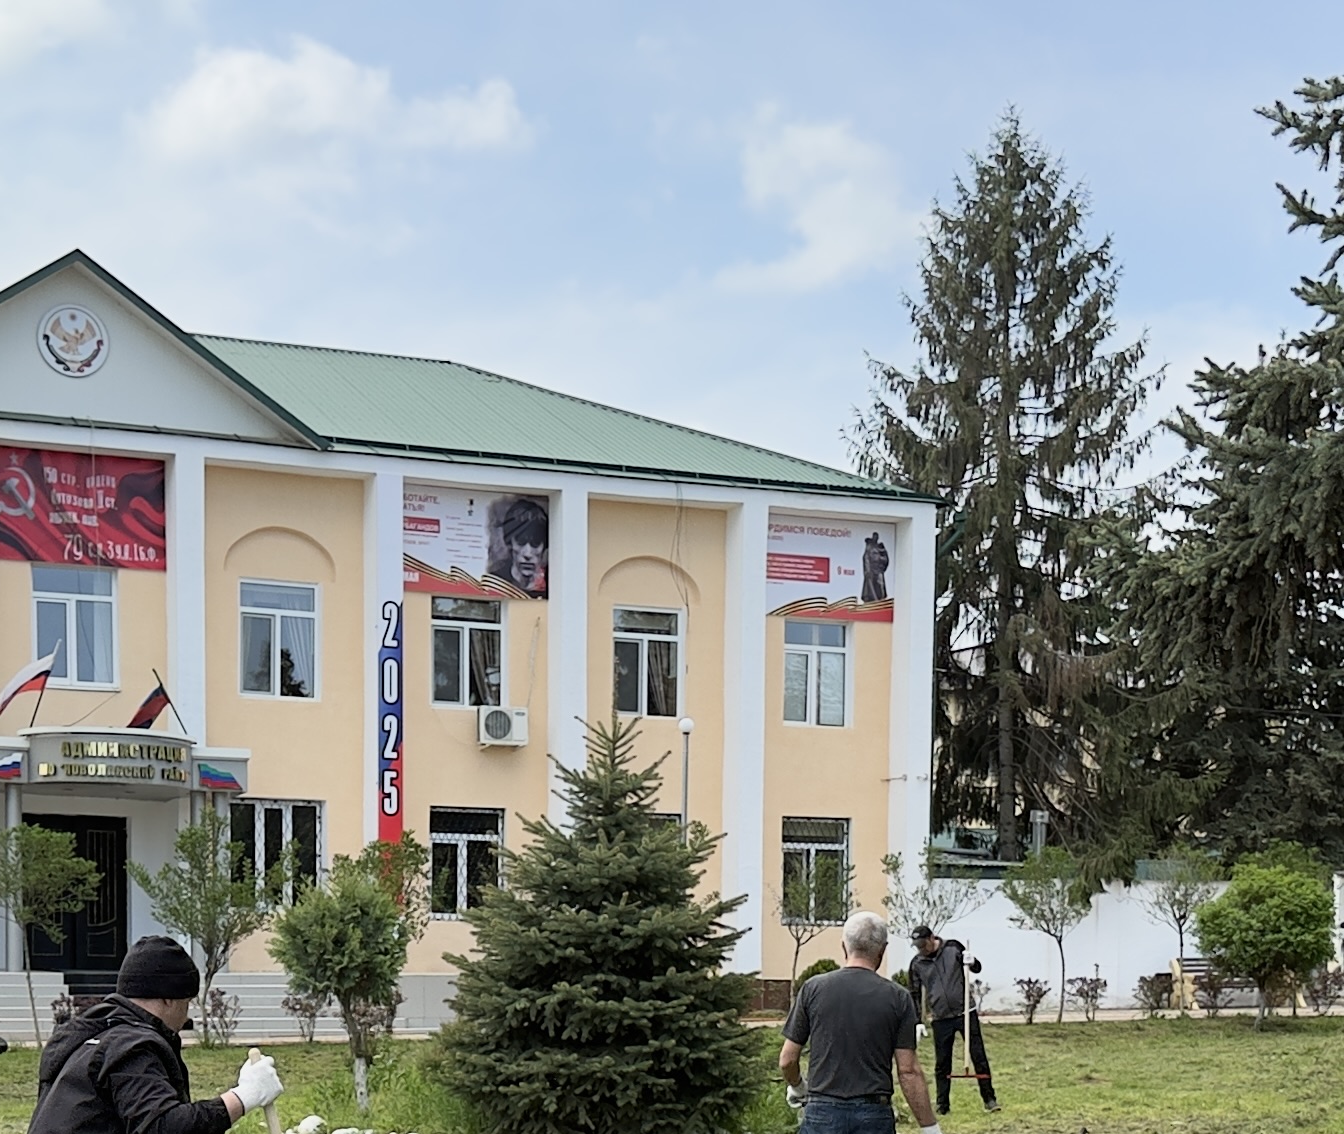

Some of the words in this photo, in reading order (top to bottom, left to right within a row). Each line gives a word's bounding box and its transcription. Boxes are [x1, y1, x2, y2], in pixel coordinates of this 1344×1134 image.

[807, 525, 852, 538] ПОБЕДОЙ!
[64, 533, 83, 560] 79
[382, 601, 400, 817] 2025
[60, 741, 187, 763] АДМИНИСТРАЦИЯ
